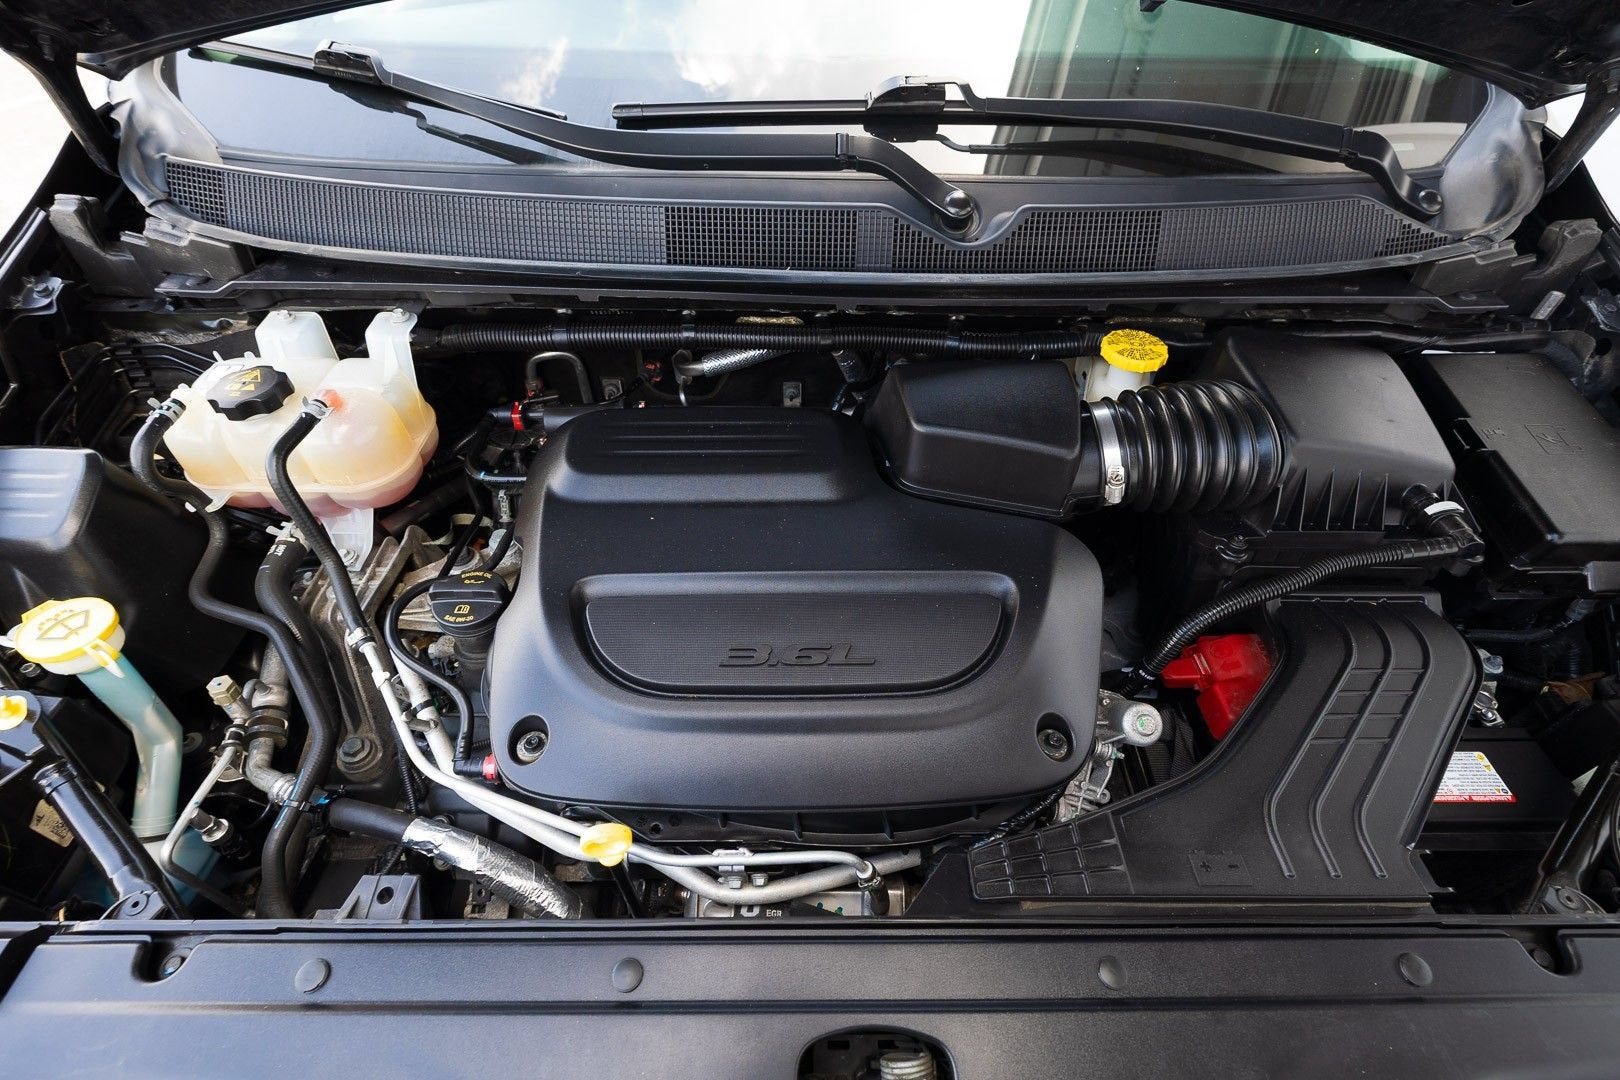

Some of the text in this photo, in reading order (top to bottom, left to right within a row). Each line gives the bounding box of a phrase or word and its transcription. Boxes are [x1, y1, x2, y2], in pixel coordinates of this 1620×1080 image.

[461, 571, 484, 579] ENGINE
[719, 643, 876, 668] 3.6L
[766, 909, 782, 918] EGR
